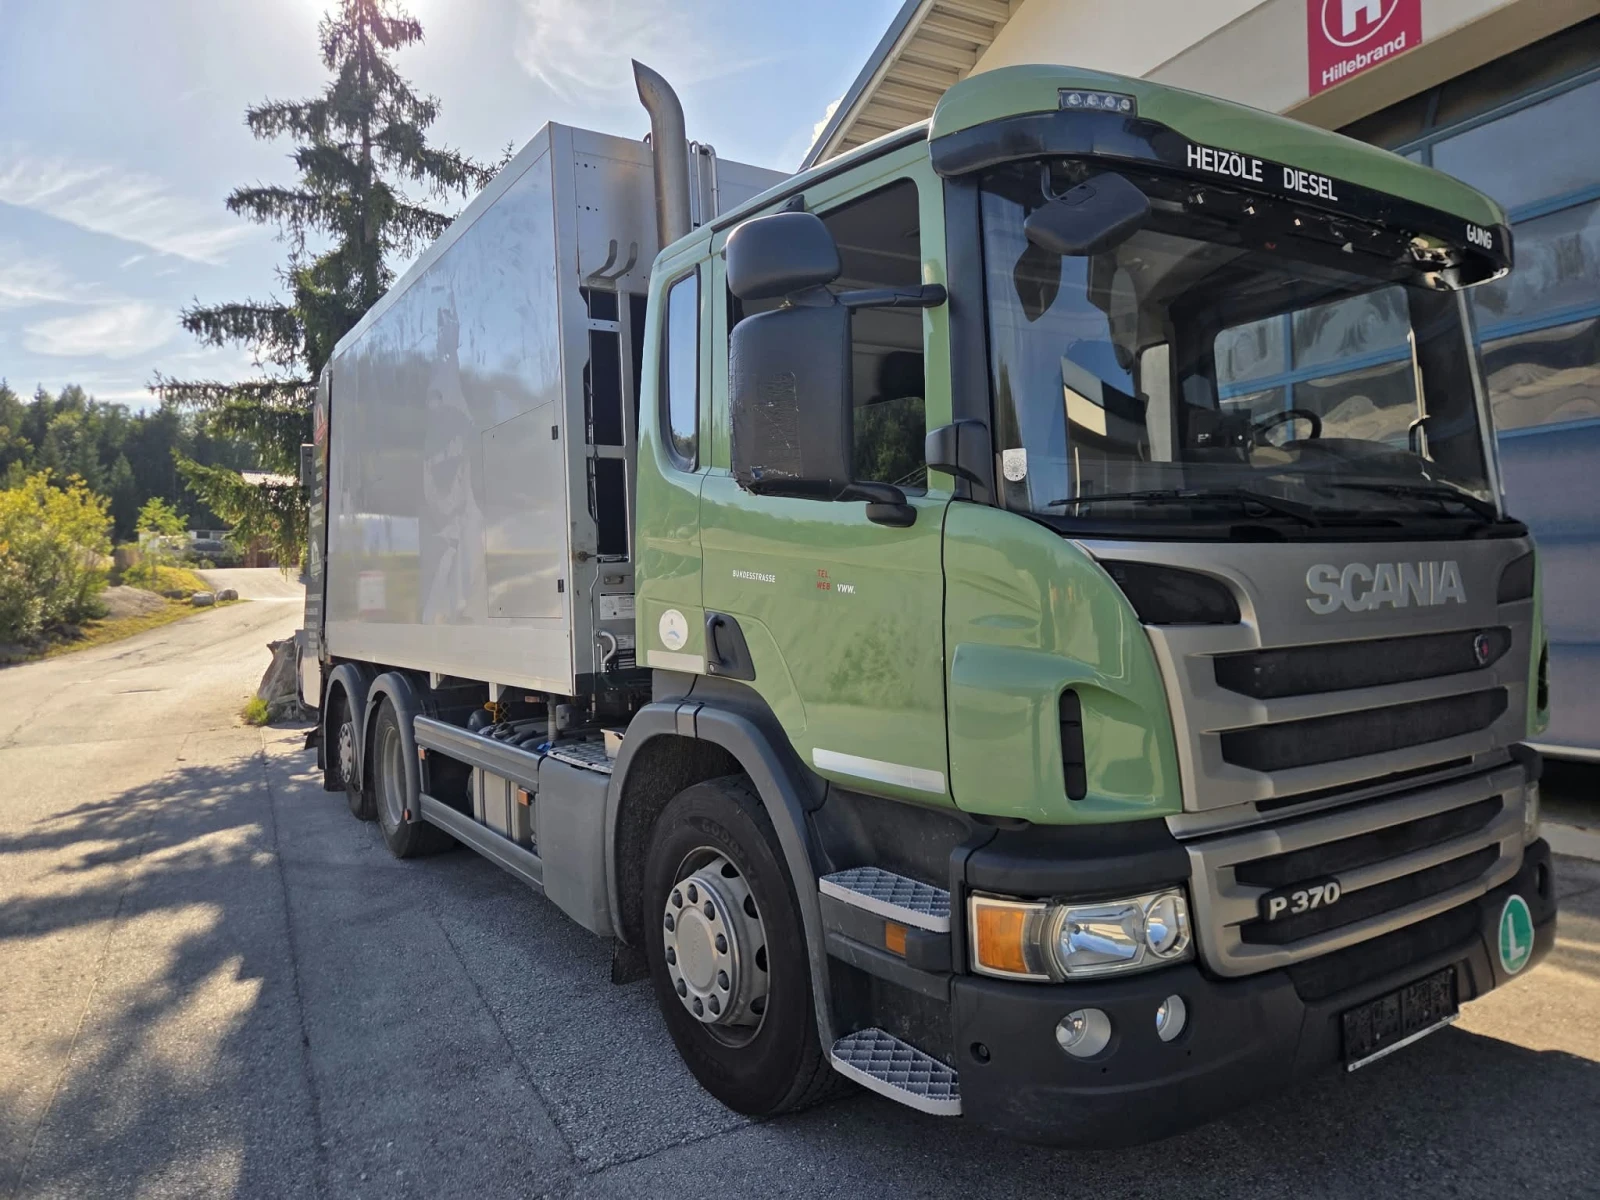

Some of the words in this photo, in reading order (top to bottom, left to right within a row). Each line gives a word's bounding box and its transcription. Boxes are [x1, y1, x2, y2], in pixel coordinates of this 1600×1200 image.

[1322, 31, 1406, 86] Hillebrand
[1187, 144, 1264, 183] HEIZÖLE
[1283, 167, 1339, 202] DIESEL
[1466, 223, 1493, 250] GUNG
[816, 581, 831, 591] WEB
[1305, 560, 1468, 615] SCANIA
[1269, 896, 1288, 921] P
[1290, 881, 1340, 914] 370
[1507, 911, 1526, 962] L
